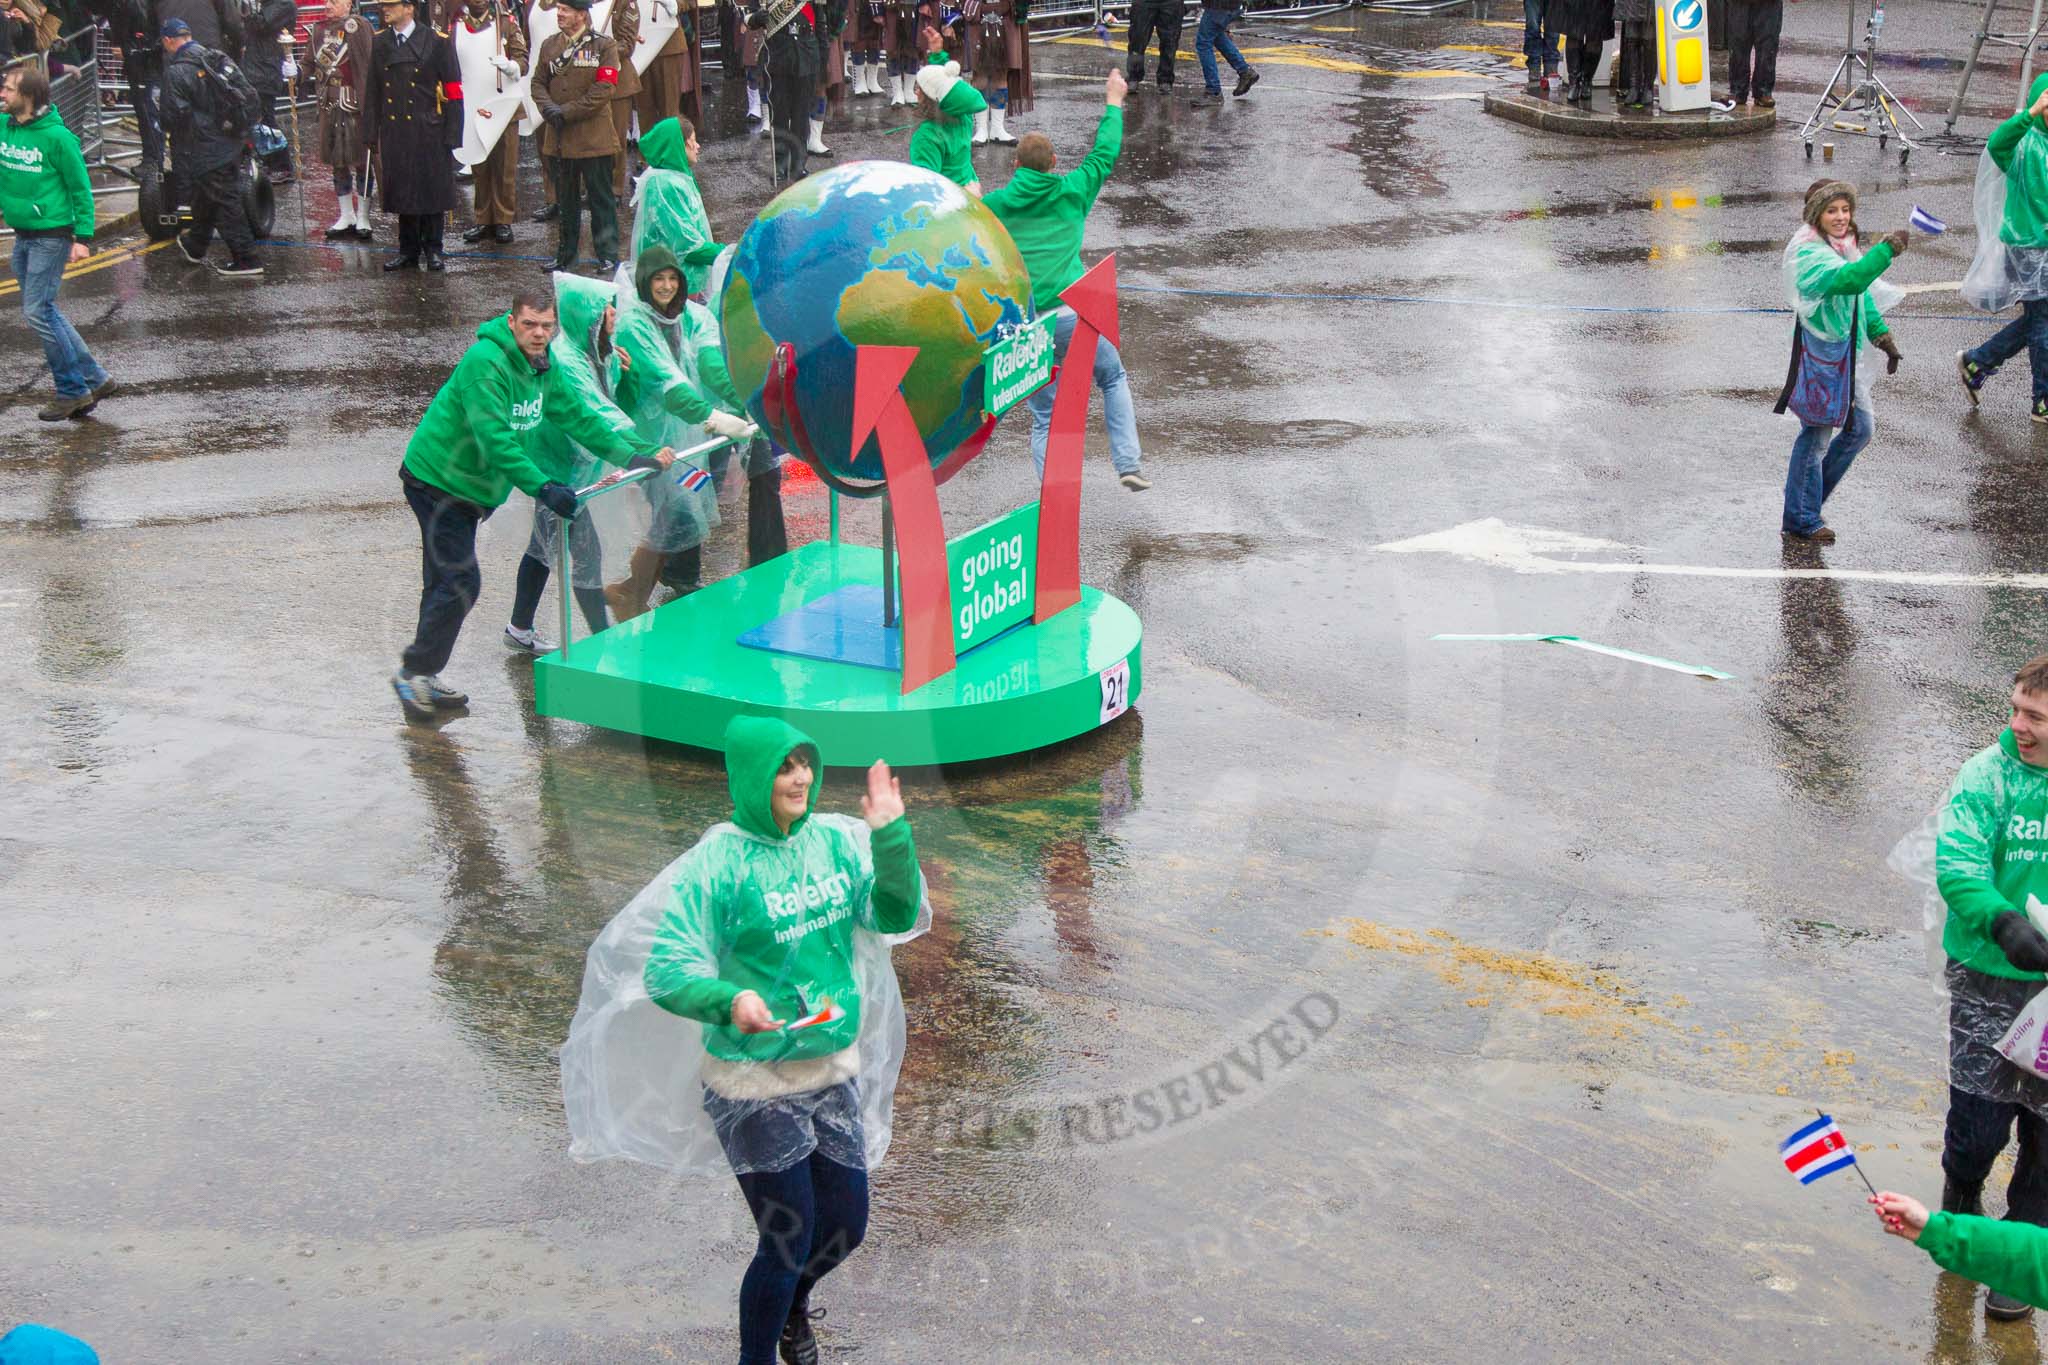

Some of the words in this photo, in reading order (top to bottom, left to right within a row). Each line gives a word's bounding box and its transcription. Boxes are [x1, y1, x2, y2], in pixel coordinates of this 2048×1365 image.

[992, 324, 1049, 386] Raleigh
[993, 359, 1049, 412] International
[962, 533, 1022, 593] going
[960, 566, 1027, 640] global
[1106, 671, 1123, 711] 21
